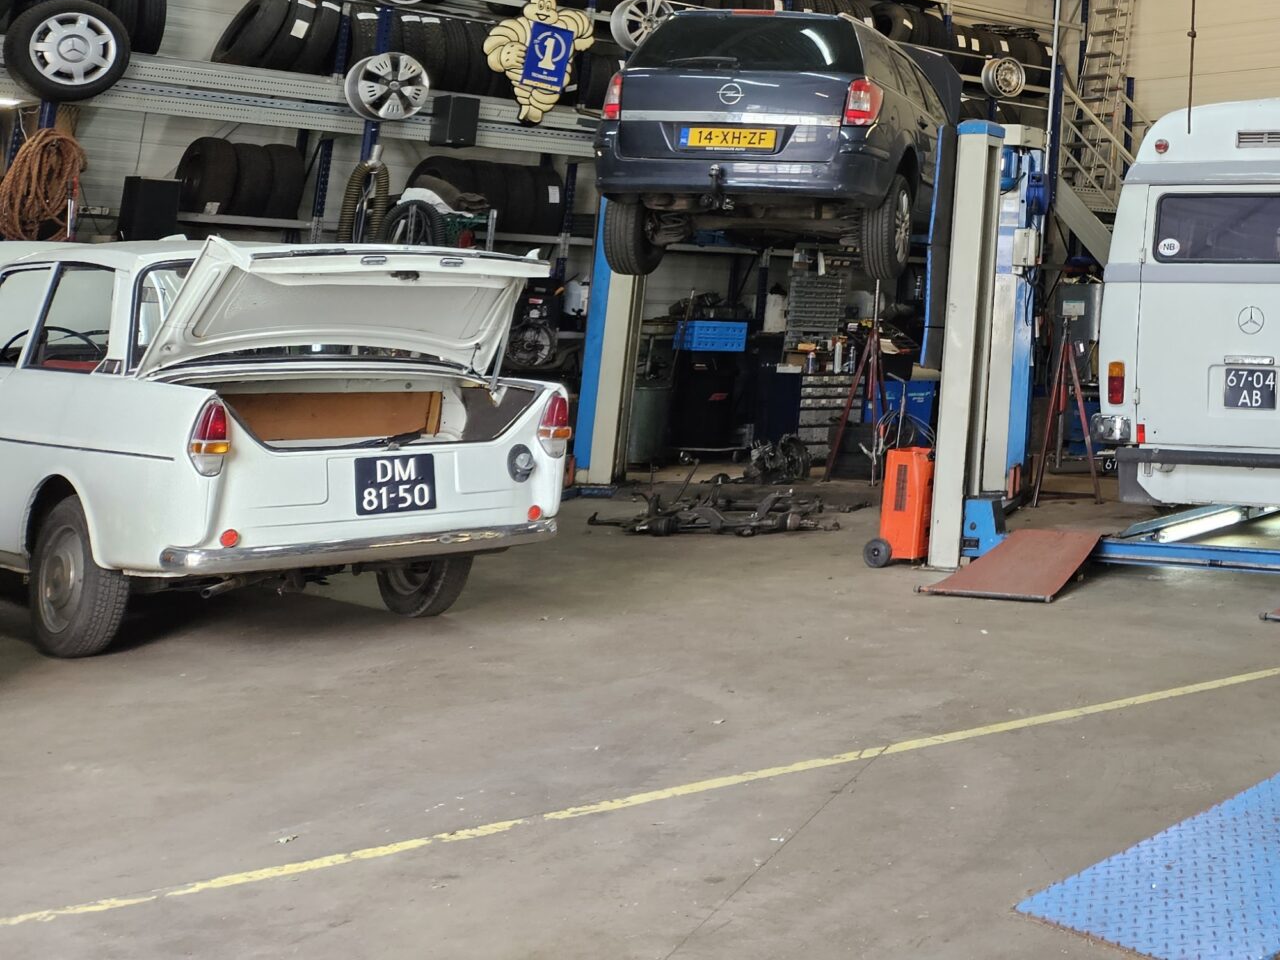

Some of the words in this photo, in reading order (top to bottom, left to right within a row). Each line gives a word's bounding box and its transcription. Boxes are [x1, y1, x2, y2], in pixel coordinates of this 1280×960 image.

[698, 130, 768, 145] 14-XH-ZF
[1237, 389, 1262, 407] AB
[376, 457, 417, 483] DM
[362, 483, 430, 511] 81-50
